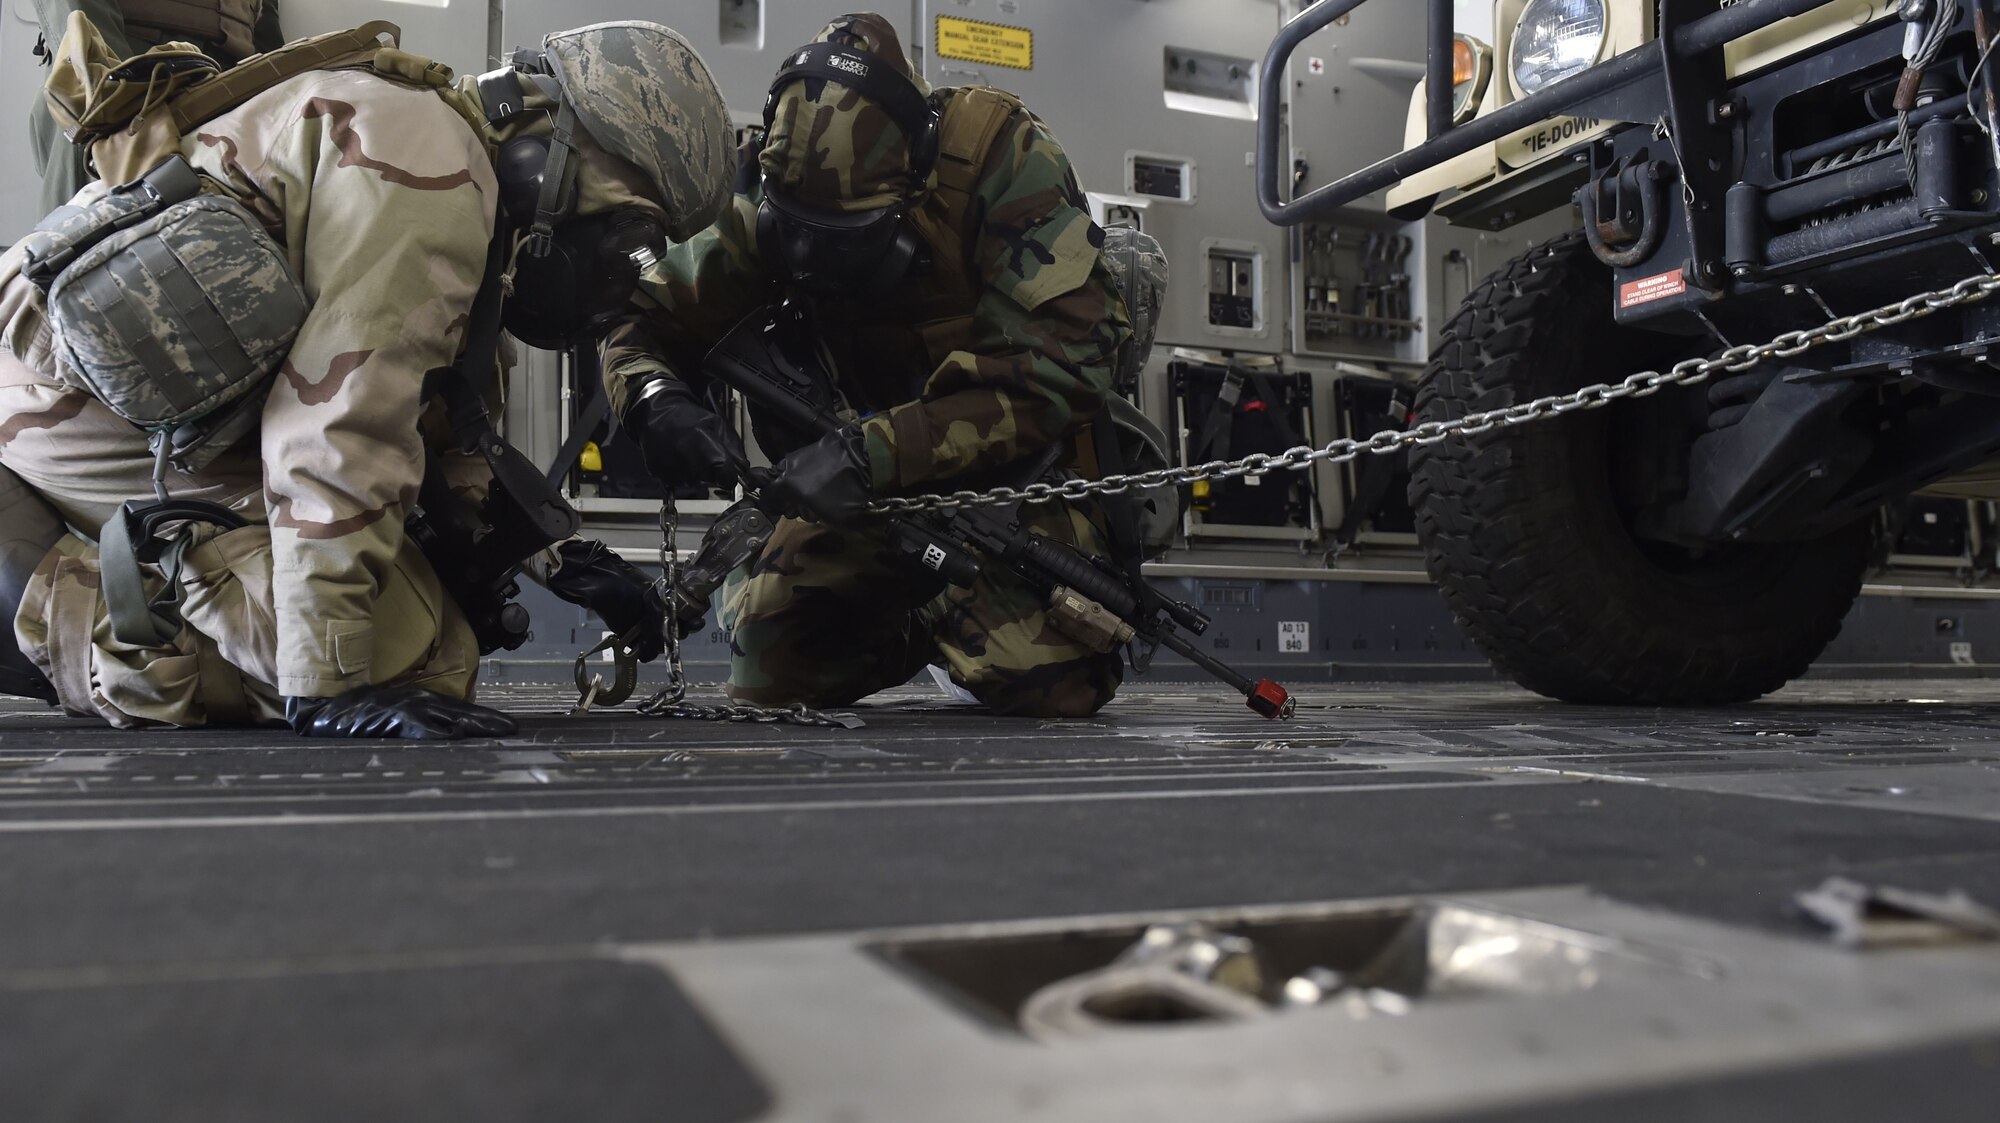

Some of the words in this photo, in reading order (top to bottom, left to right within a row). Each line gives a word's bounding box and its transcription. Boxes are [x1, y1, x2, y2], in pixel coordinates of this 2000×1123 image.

[841, 58, 869, 74] LEIGHT
[1522, 117, 1599, 152] TIE-DOWN
[1627, 290, 1642, 299] STAND
[1641, 286, 1657, 295] CLEAR
[1663, 280, 1679, 289] WINCH
[1637, 275, 1668, 289] WARNING
[1638, 292, 1656, 302] DURING
[1656, 286, 1682, 298] OPERATION
[1296, 623, 1306, 633] 13
[711, 631, 730, 644] 910
[1285, 640, 1302, 651] 840
